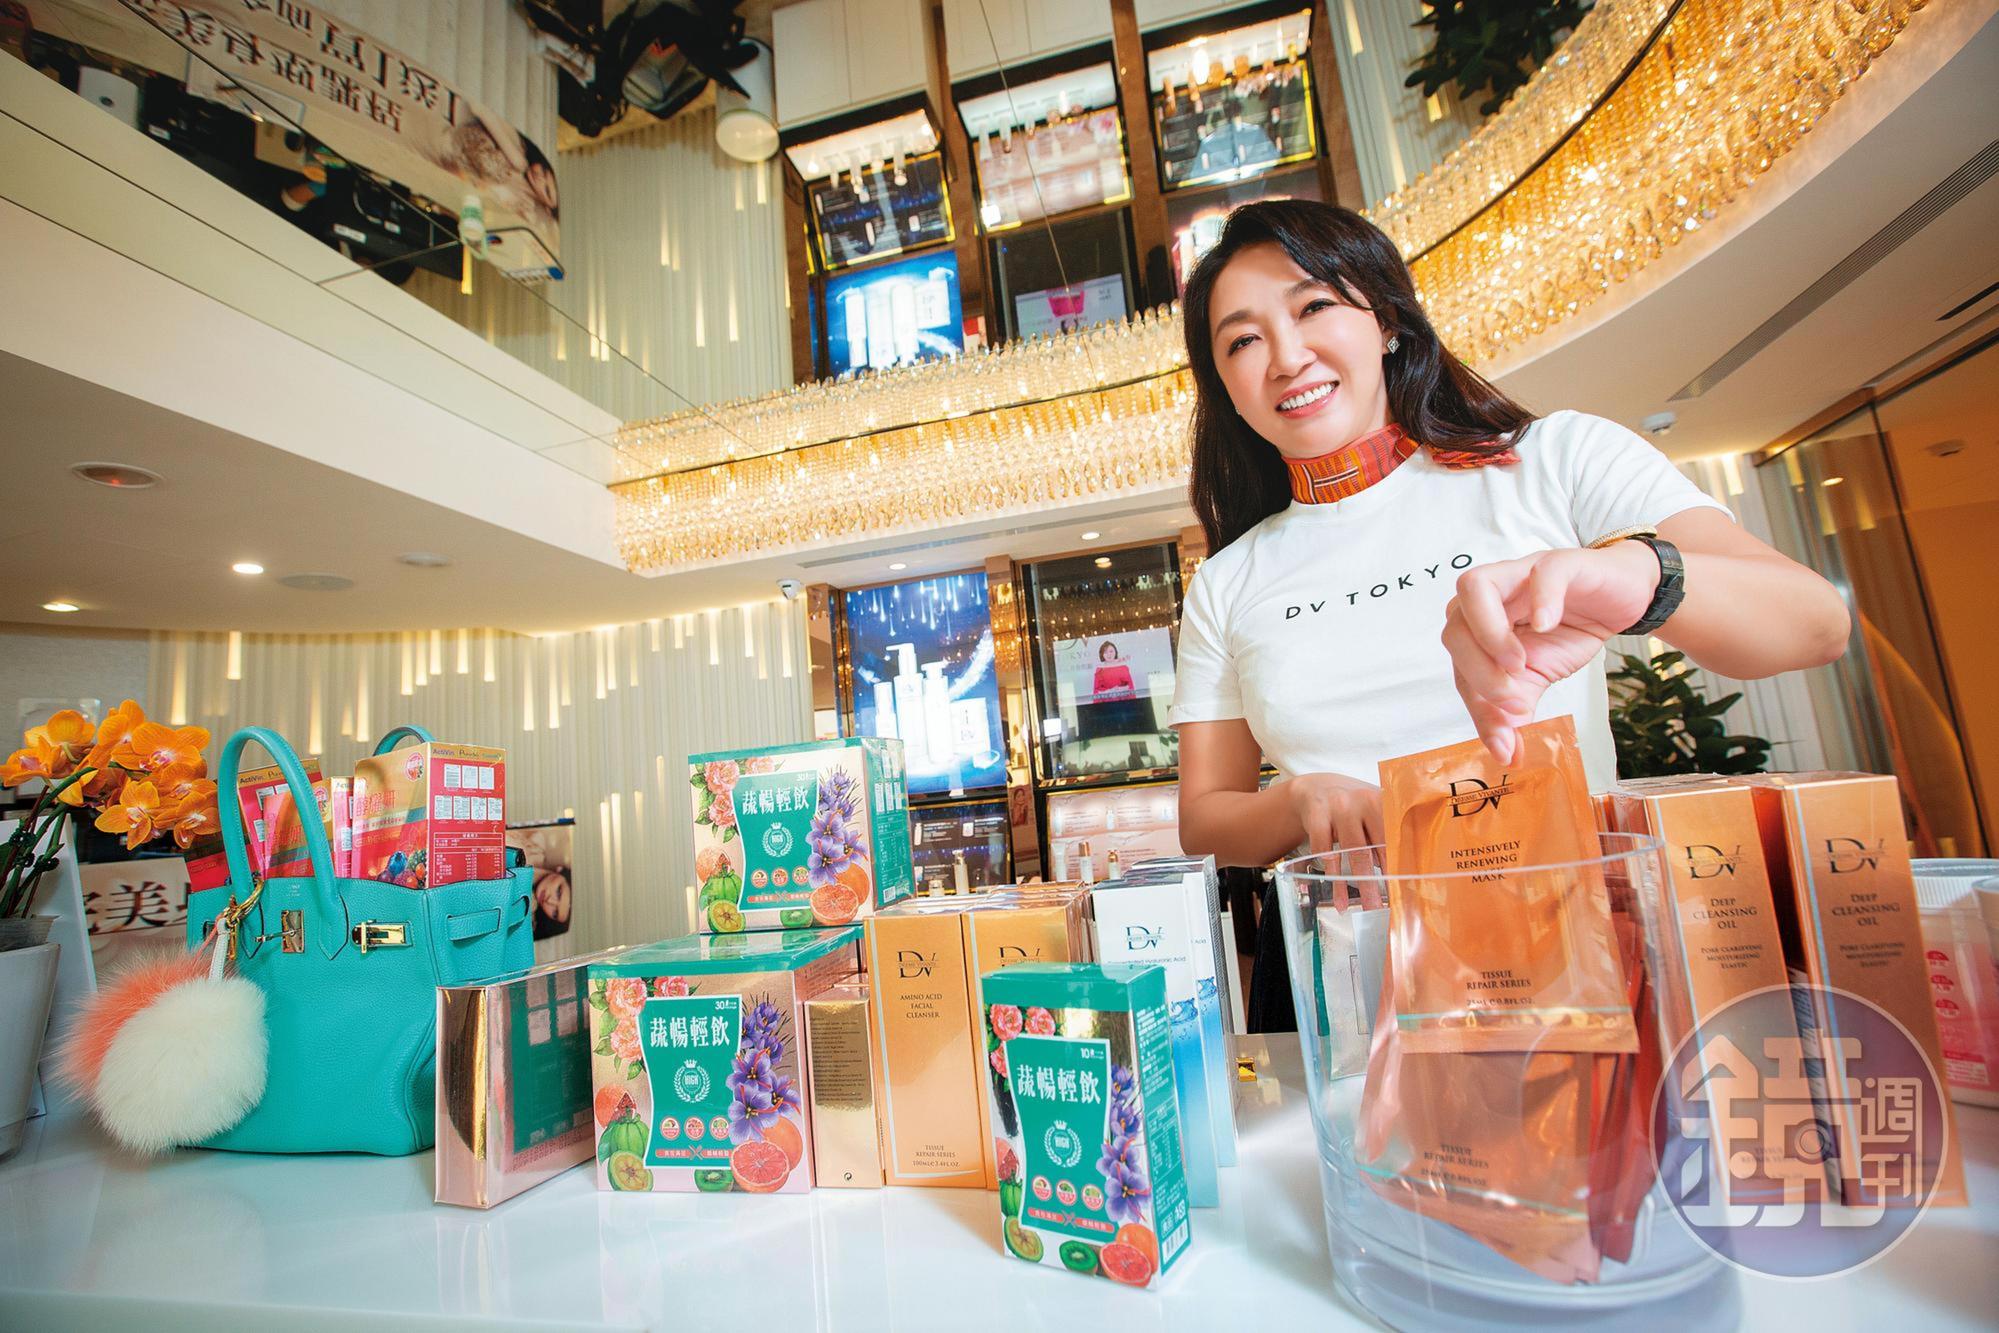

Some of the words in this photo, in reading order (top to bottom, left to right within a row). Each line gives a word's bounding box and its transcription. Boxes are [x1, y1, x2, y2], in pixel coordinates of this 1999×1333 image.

[1286, 600, 1326, 620] DV
[1346, 554, 1473, 606] TOKYO
[742, 786, 810, 815] 蔬暢輕飲
[1449, 774, 1509, 818] DV
[1450, 840, 1520, 859] INTENSIVELY
[1826, 838, 1885, 873] DV
[1456, 853, 1517, 869] RENEWING
[1685, 844, 1741, 879] DV
[1472, 873, 1505, 884] MASK
[1711, 898, 1736, 907] DEEP
[1850, 893, 1877, 903] DEEP
[1693, 907, 1757, 920] CLEANSING
[1832, 903, 1900, 916] CLEANSING
[1717, 920, 1738, 929] OIL
[1857, 917, 1878, 927] OIL
[1126, 926, 1163, 950] DV
[897, 950, 936, 978] DV
[1481, 970, 1513, 980] TISSUE
[1466, 981, 1498, 990] REPAIR
[1500, 979, 1532, 989] SERIES
[650, 1016, 730, 1048] 蔬暢輕飲
[1017, 1064, 1101, 1104] 蔬暢輕飲
